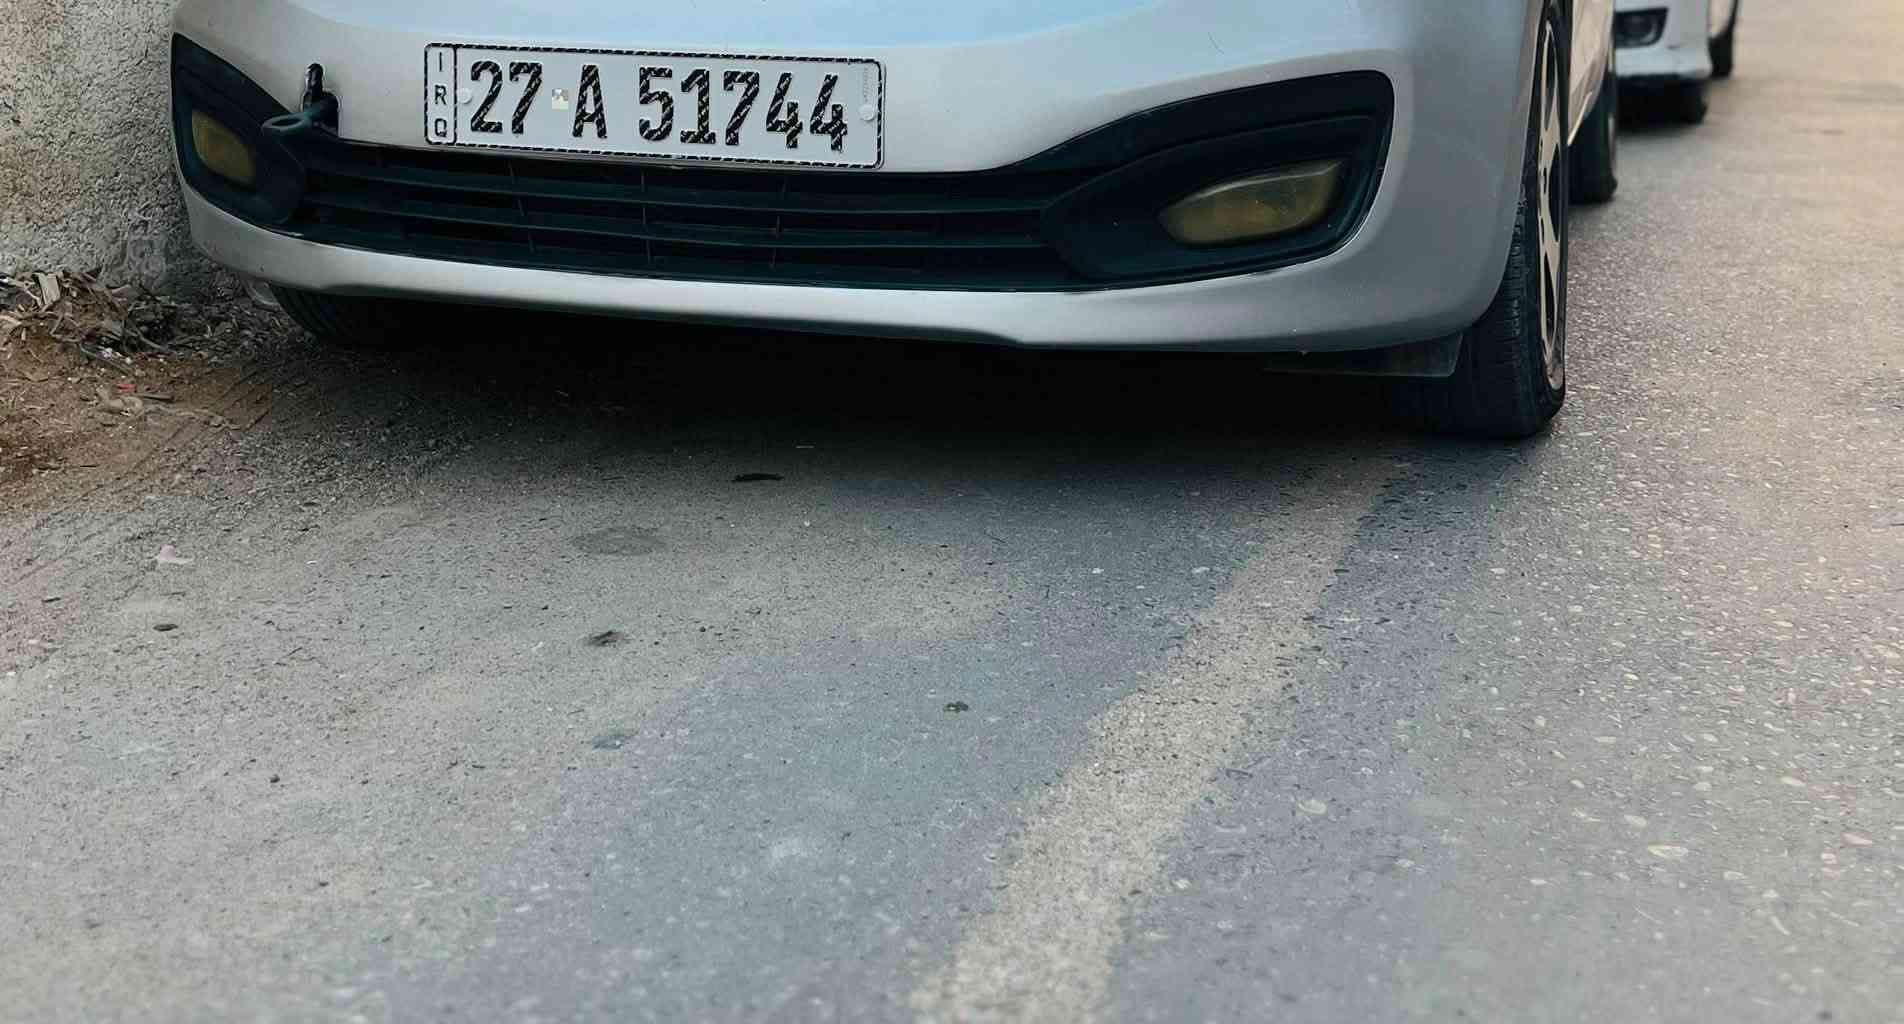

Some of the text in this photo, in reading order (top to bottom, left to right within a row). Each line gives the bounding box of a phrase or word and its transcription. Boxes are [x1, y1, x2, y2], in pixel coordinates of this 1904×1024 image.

[434, 51, 448, 138] IRQ
[470, 60, 543, 135] 27
[572, 64, 608, 139] A
[638, 66, 848, 152] 51744
